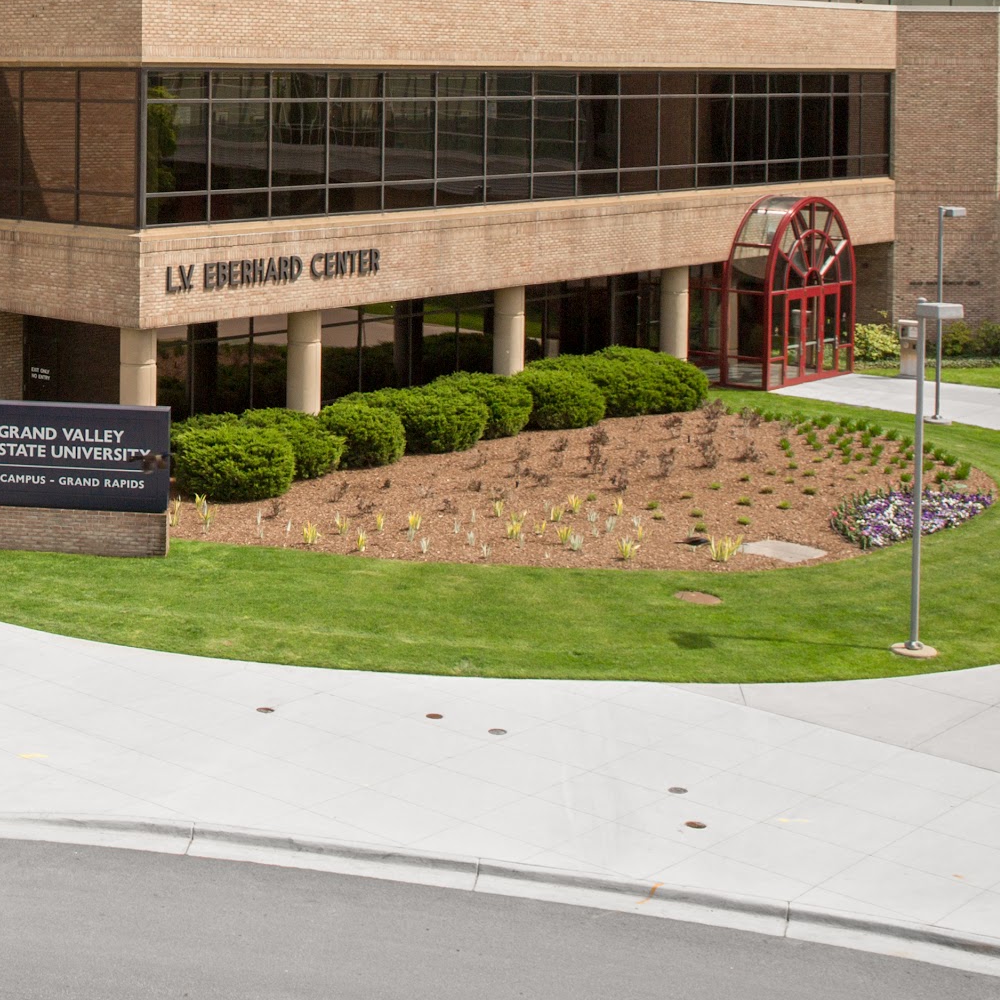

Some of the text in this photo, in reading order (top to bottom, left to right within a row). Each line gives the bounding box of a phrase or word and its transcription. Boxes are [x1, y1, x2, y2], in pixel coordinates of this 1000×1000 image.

[204, 256, 302, 289] EBERHARD
[310, 248, 381, 277] CENTER
[62, 428, 125, 444] VALLEY
[0, 473, 46, 485] CAMPUS
[58, 476, 100, 488] GRAND
[104, 478, 145, 490] RAPIDS
